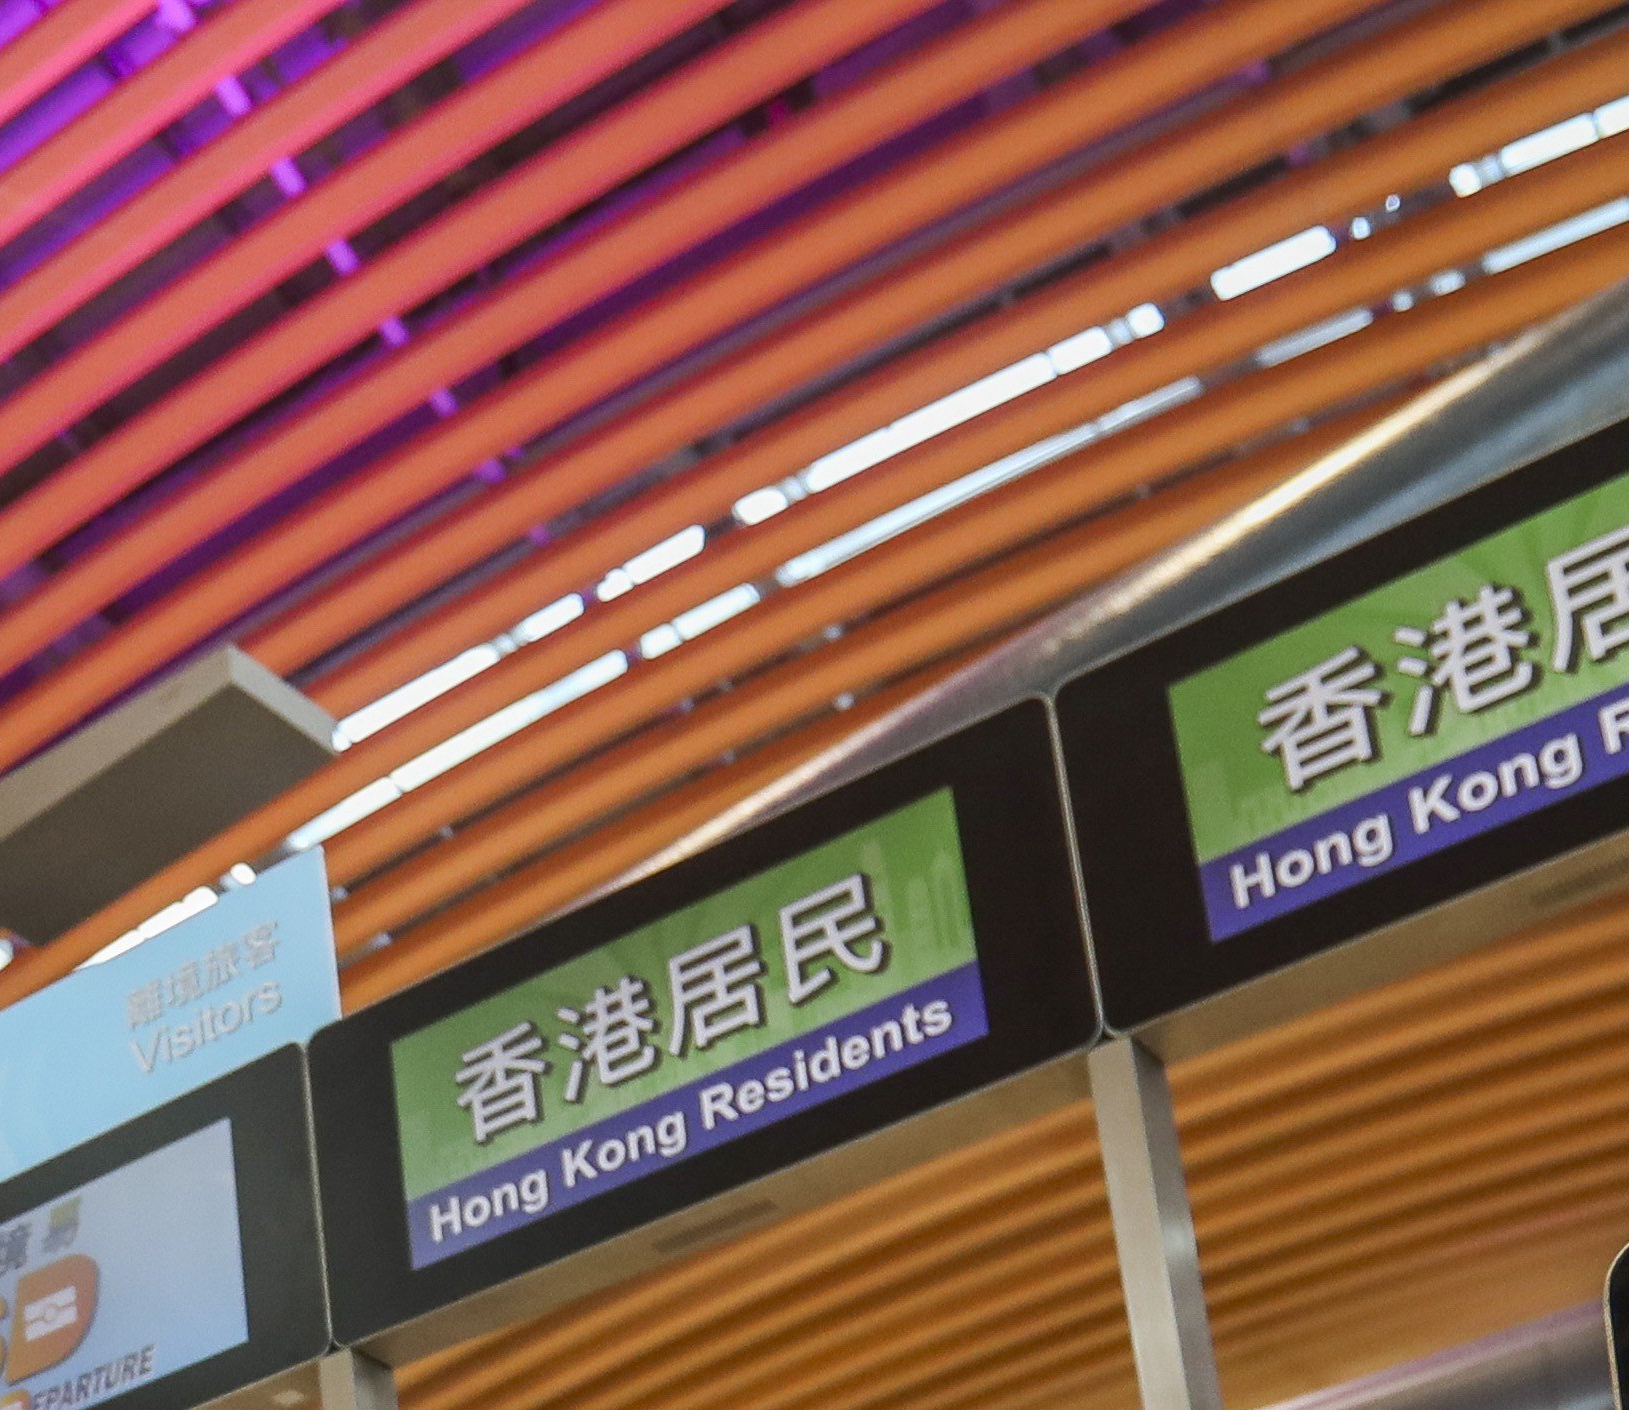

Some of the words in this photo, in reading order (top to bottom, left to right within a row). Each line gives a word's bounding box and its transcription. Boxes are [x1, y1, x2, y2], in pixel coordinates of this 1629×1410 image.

[1228, 811, 1396, 911] Hong
[1408, 732, 1584, 836] Kong
[130, 980, 283, 1074] Visitors
[455, 873, 887, 1142] 香港居民
[428, 1168, 550, 1243] Hong
[561, 1111, 687, 1189] Kong
[699, 997, 954, 1131] Residents
